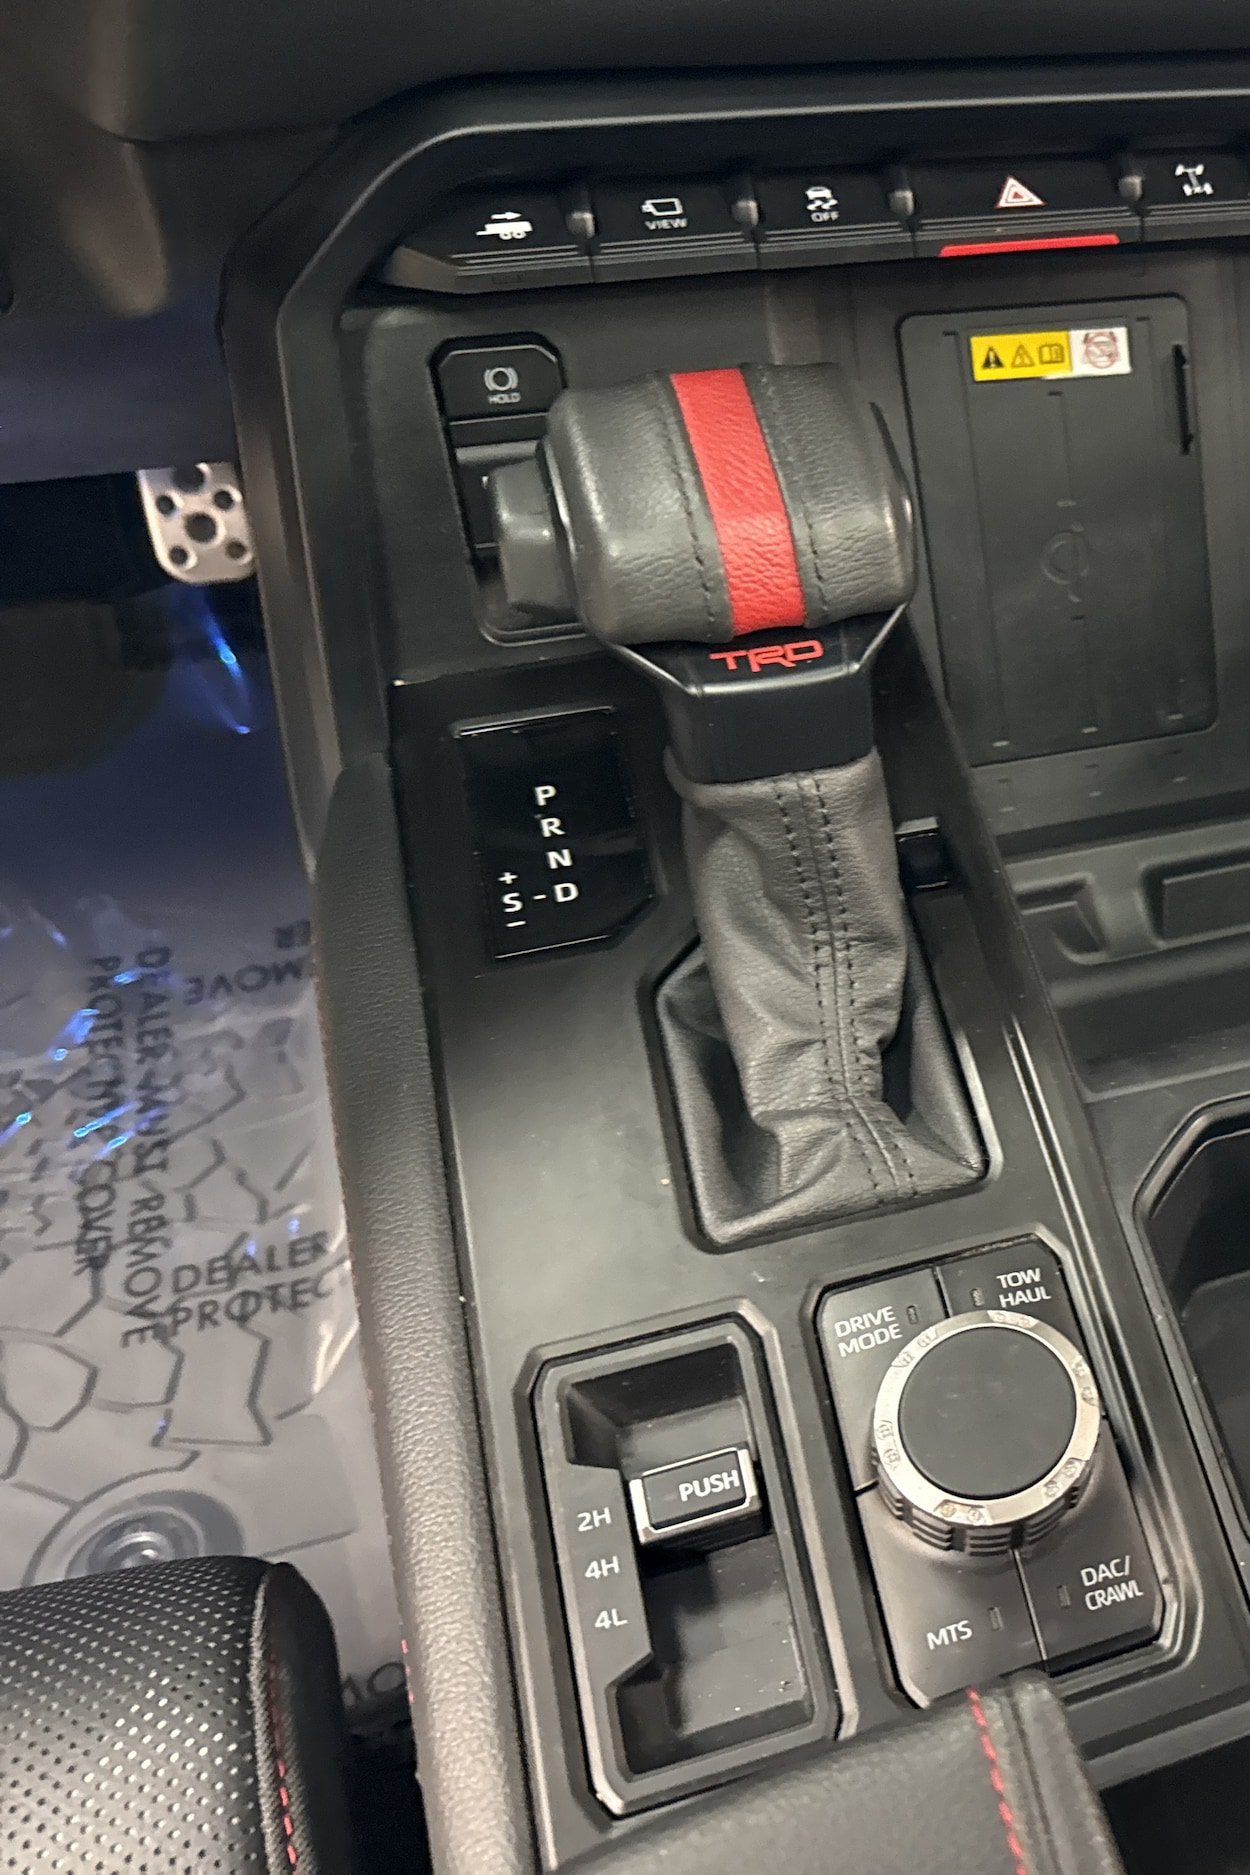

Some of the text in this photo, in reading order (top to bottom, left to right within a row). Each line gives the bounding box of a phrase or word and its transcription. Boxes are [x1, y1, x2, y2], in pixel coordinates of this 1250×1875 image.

[644, 218, 687, 231] VIEW
[810, 209, 840, 224] OFF
[488, 391, 521, 404] HOLD
[709, 640, 824, 673] TRD
[534, 785, 556, 806] P
[541, 818, 565, 838] R
[547, 849, 573, 869] N
[502, 883, 579, 913] S D
[996, 1268, 1041, 1289] TOW
[999, 1286, 1052, 1308] HAUL
[833, 1306, 897, 1339] DRIVE
[837, 1322, 904, 1358] MODE
[678, 1470, 739, 1501] PUSH
[576, 1507, 612, 1533] 2H
[583, 1556, 621, 1579] 4H
[1080, 1555, 1132, 1586] DAC/
[1084, 1580, 1144, 1611] CRAWL
[593, 1609, 629, 1630] 4L
[926, 1621, 973, 1651] MTS
